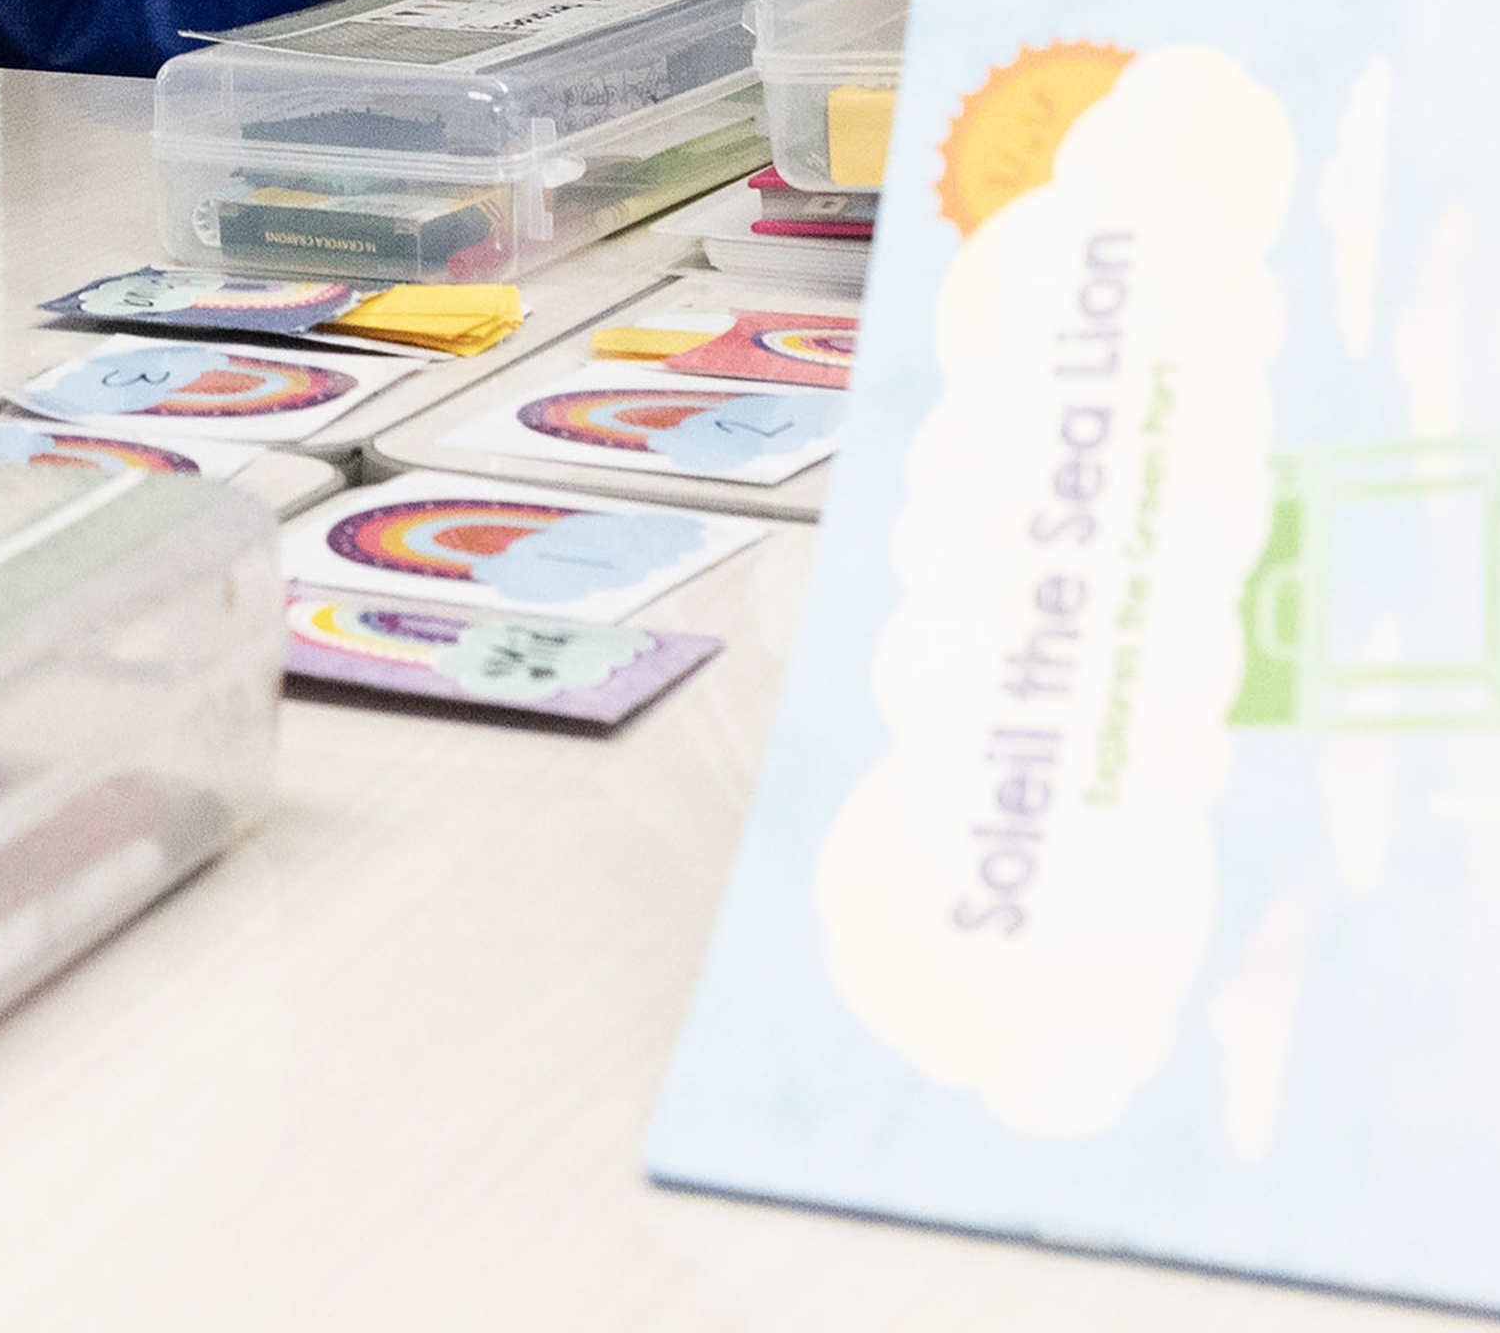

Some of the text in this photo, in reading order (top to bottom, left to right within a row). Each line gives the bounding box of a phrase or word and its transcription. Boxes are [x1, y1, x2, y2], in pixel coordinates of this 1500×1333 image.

[951, 228, 1136, 936] Soleil the Sea Lion
